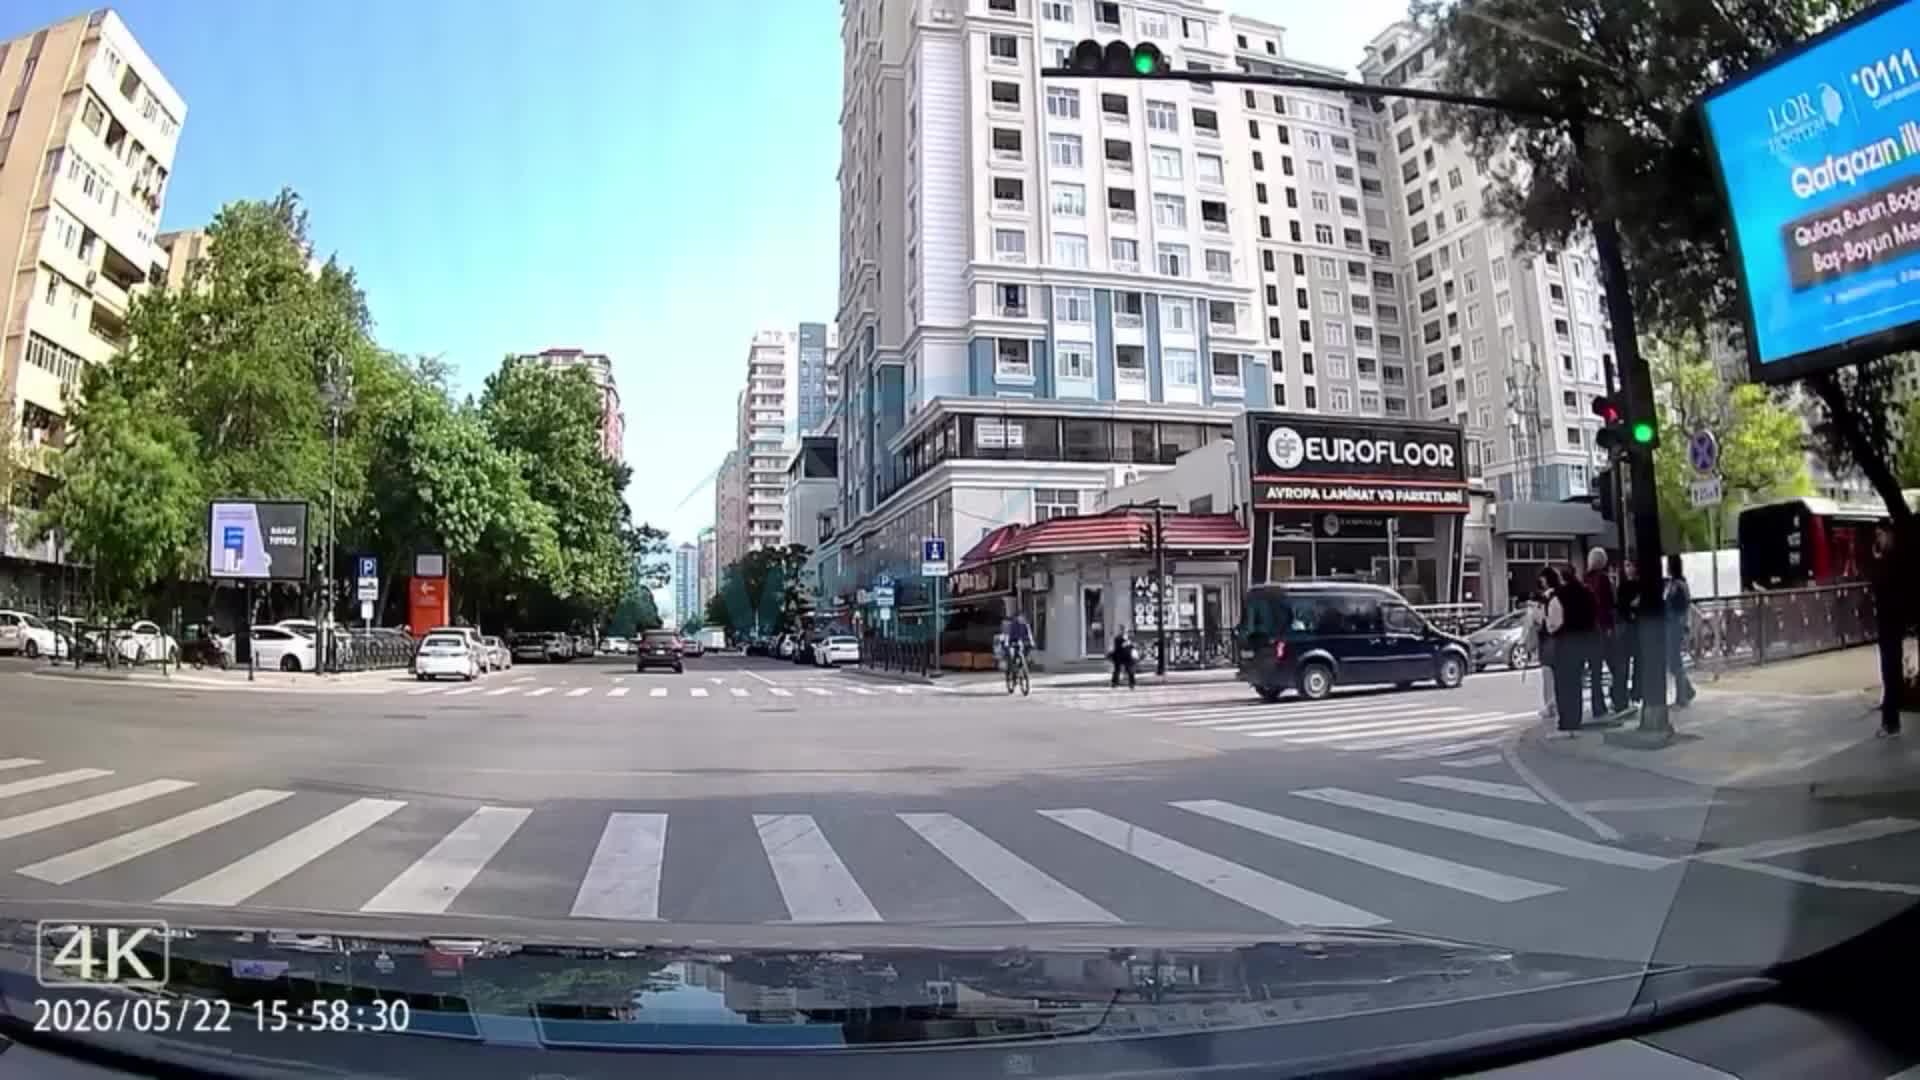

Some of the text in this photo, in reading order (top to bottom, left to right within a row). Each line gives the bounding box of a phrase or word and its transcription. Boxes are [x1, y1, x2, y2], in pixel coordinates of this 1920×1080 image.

[1768, 93, 1817, 132] LOR
[1305, 437, 1454, 467] EUROFLOOR
[1267, 487, 1321, 500] AVROPA
[1322, 486, 1376, 501] LAMİNAT
[1377, 490, 1394, 502] VƏ
[363, 560, 373, 576] P
